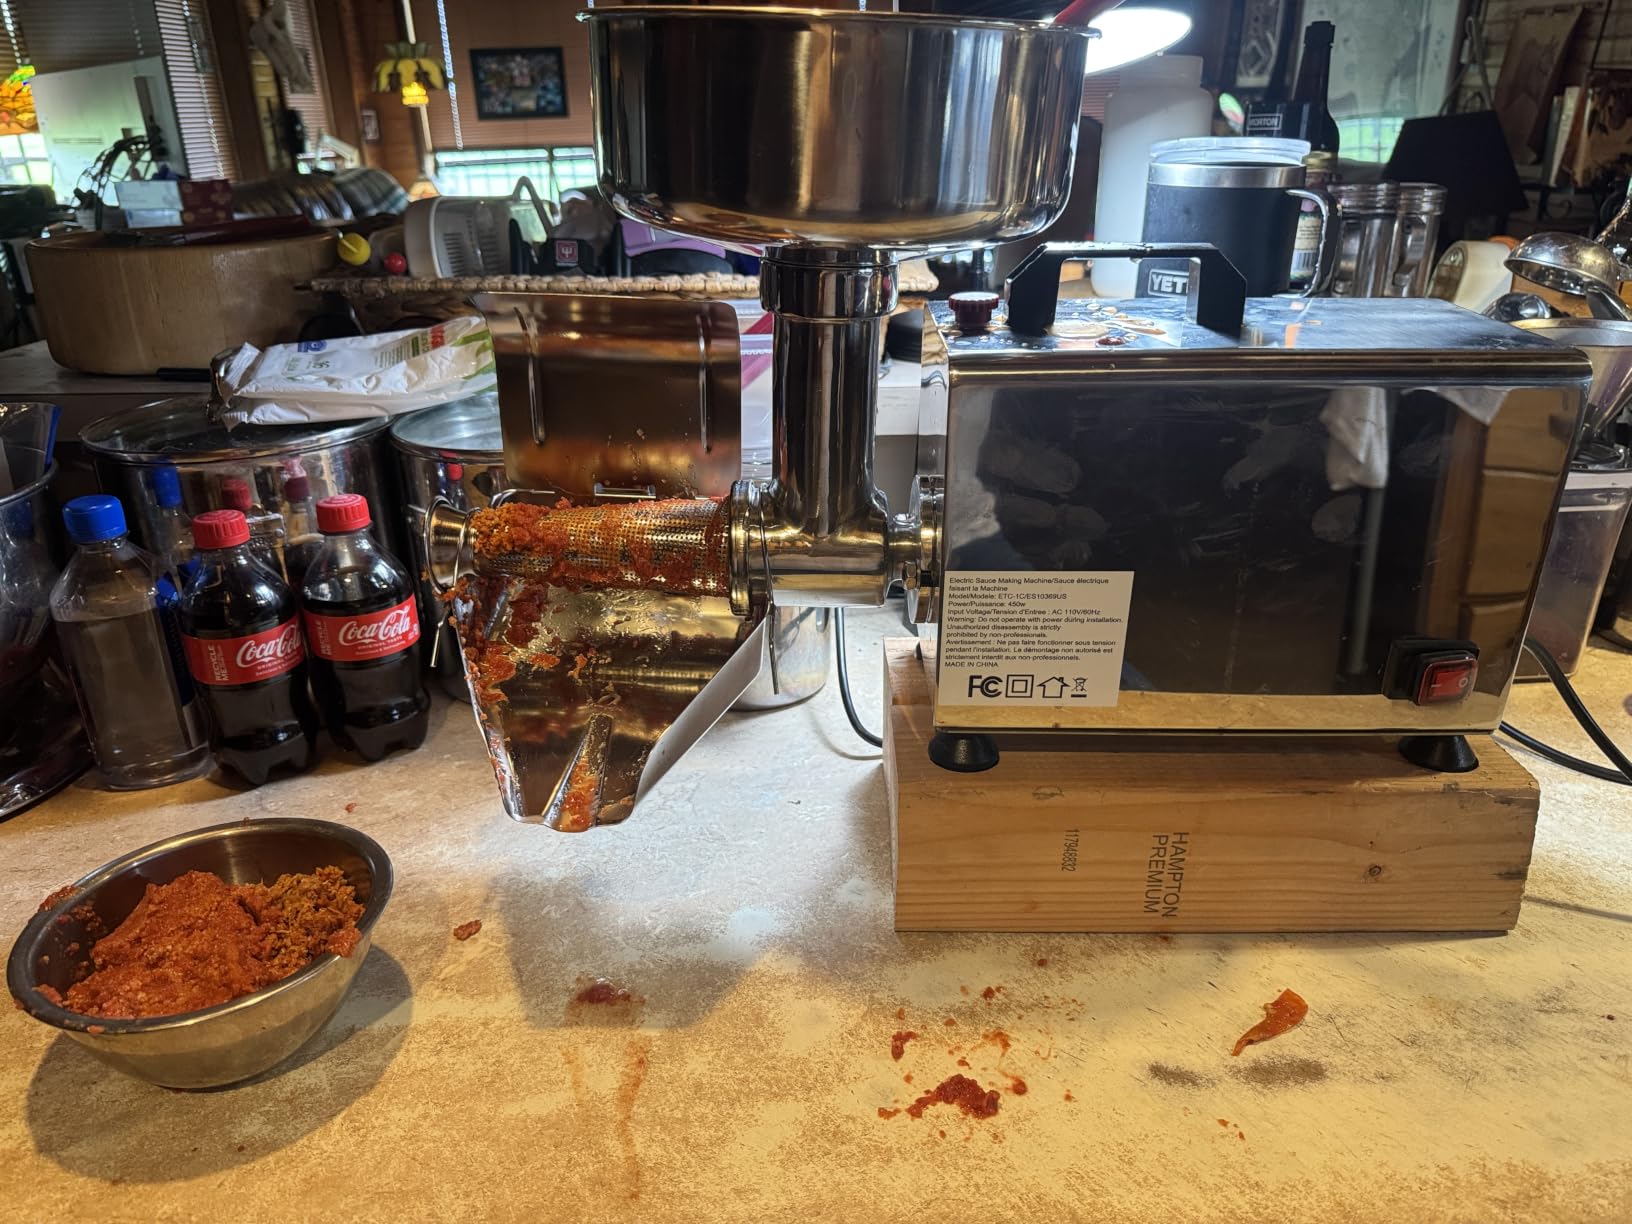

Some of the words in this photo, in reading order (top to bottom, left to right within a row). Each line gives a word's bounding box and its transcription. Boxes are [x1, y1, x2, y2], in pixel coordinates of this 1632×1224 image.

[338, 604, 411, 646] Coca-Cola
[1143, 834, 1169, 914] PREMIUM
[1162, 832, 1190, 918] HAMPTON
